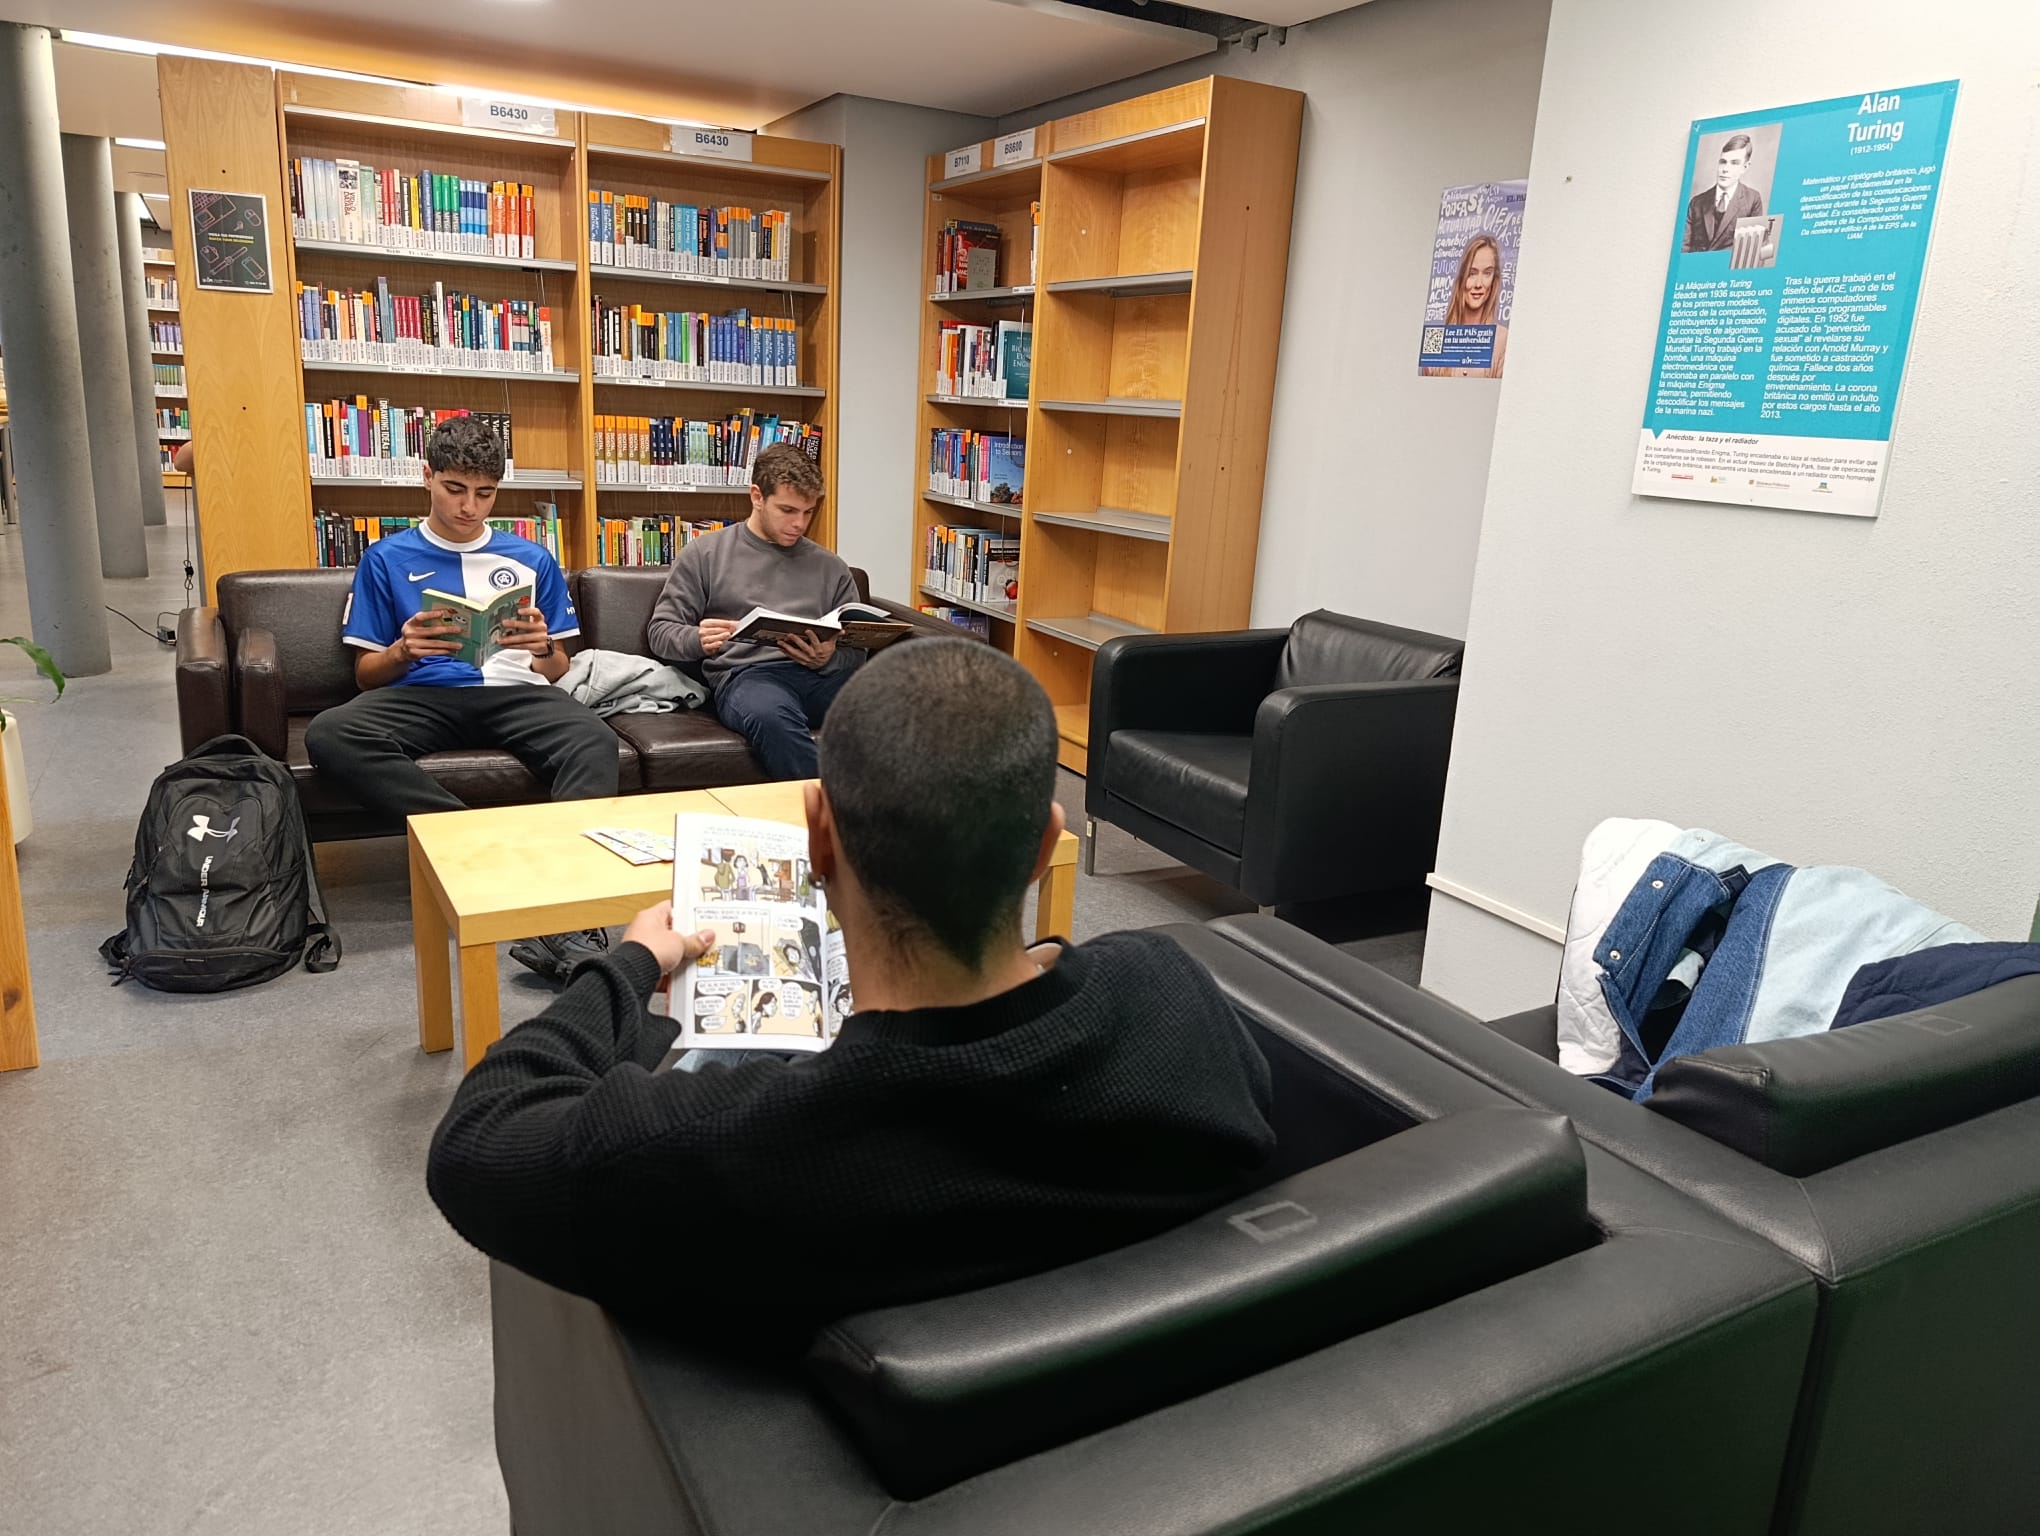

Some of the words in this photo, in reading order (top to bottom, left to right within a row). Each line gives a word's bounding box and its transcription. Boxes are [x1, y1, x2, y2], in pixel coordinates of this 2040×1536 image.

[1857, 93, 1900, 115] Alan
[490, 105, 528, 120] B6430
[1847, 119, 1904, 142] Turing
[695, 132, 729, 146] B6430
[1850, 142, 1894, 156] (1912-1954)
[1785, 276, 1802, 285] Tras
[1812, 276, 1840, 286] guerra
[1842, 273, 1872, 283] trabajó
[1886, 272, 1896, 280] el
[1685, 282, 1716, 291] Máquina
[1730, 279, 1752, 289] Turing
[1782, 286, 1809, 295] diseño
[1810, 285, 1824, 293] del
[1867, 283, 1879, 291] de
[1673, 291, 1697, 299] ideada
[1710, 289, 1728, 298] 1936
[1729, 290, 1756, 298] supuso
[1694, 300, 1726, 309] primeros
[1726, 298, 1759, 306] modelos
[1780, 296, 1816, 306] primeros
[1817, 293, 1877, 304] computadores
[1718, 307, 1766, 317] computación,
[1779, 305, 1827, 314] electrónicos
[1828, 303, 1887, 314] programables
[1669, 317, 1718, 327] contribuyendo
[1726, 316, 1734, 324] la
[1814, 314, 1826, 322] En
[1829, 313, 1850, 322] 1952
[1850, 313, 1865, 321] fue
[1464, 328, 1478, 337] PAÍS
[1679, 326, 1712, 336] concepto
[1775, 324, 1810, 333] acusado
[1703, 335, 1736, 345] Segunda
[1813, 333, 1852, 342] revelarse
[1694, 344, 1716, 354] Turing
[1716, 344, 1742, 354] trabajó
[1772, 344, 1803, 352] relación
[1820, 343, 1849, 351] Arnold
[1850, 343, 1881, 353] Murray
[1705, 353, 1736, 363] máquina
[1784, 353, 1821, 361] sometido
[1803, 363, 1834, 371] Fallece
[1660, 371, 1698, 379] funcionaba
[1709, 371, 1739, 381] paralelo
[1766, 372, 1801, 382] después
[1801, 374, 1816, 382] por
[1666, 380, 1697, 390] máquina
[1697, 380, 1726, 390] Enigma
[1657, 389, 1688, 399] alemana,
[1690, 389, 1732, 399] permitiendo
[1763, 391, 1797, 400] británica
[1810, 392, 1836, 400] emitió
[1850, 393, 1879, 401] indulto
[1656, 397, 1697, 406] descodificar
[1710, 400, 1745, 409] mensajes
[1761, 402, 1776, 410] por
[1799, 403, 1827, 411] cargos
[379, 400, 390, 432] DRAWING
[1672, 407, 1697, 415] marina
[1760, 409, 1781, 418] 2013.
[381, 432, 390, 450] IDEAS
[200, 856, 214, 887] UNDER
[196, 888, 210, 927] ARMOUR
